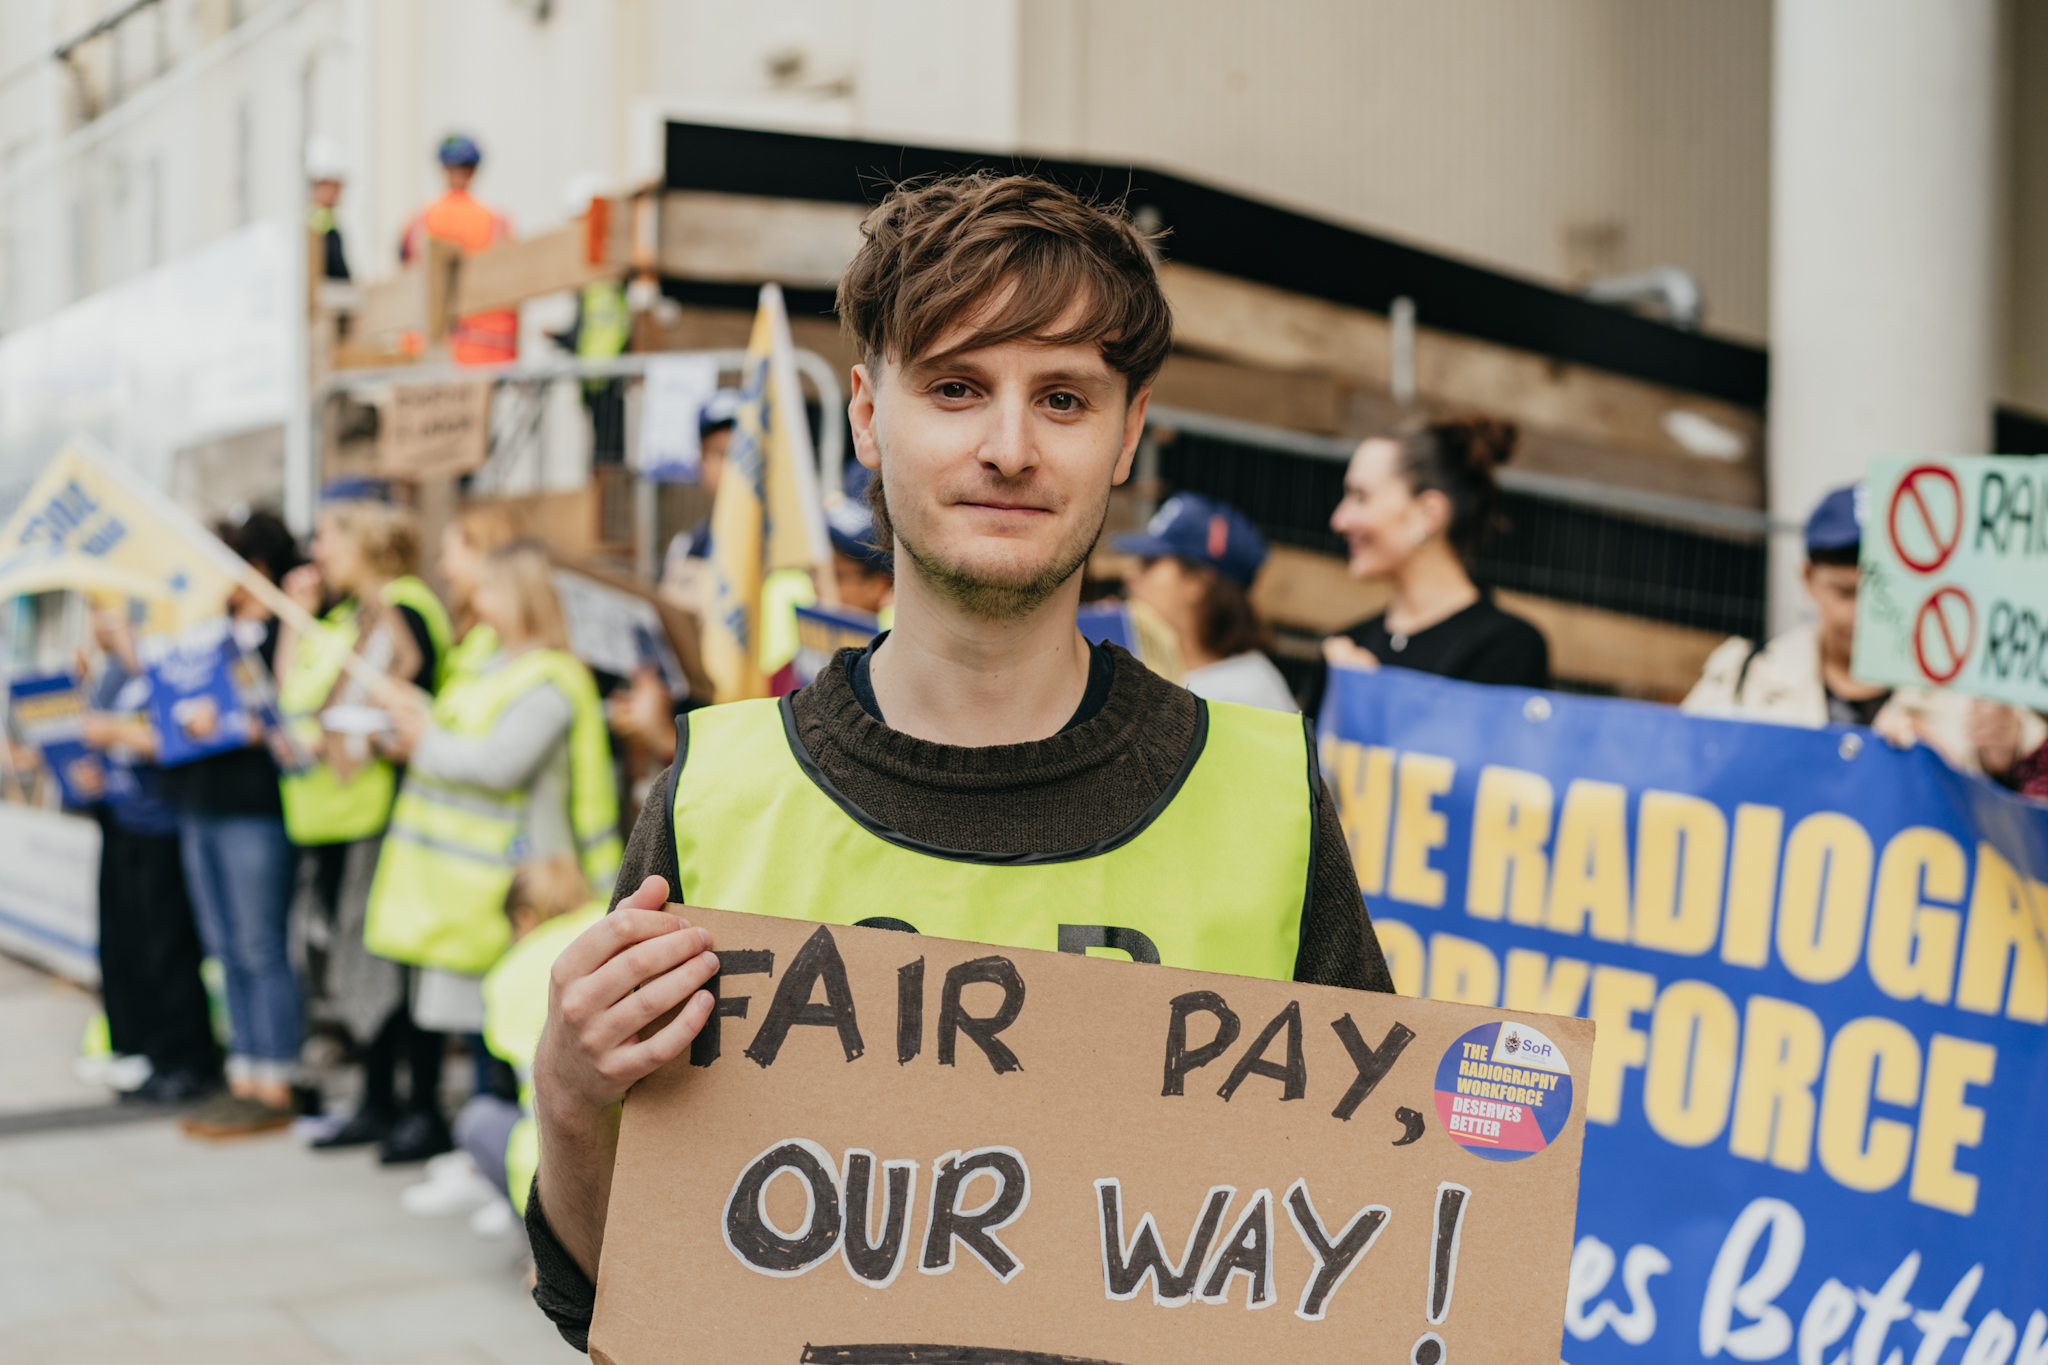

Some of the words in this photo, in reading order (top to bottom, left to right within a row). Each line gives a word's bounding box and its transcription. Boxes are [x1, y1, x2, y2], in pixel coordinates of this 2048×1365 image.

[1466, 764, 2048, 1026] RADIOGR
[690, 925, 1026, 1074] FAIR
[1161, 990, 1426, 1146] PAY,
[1522, 1039, 1552, 1057] SoR
[1463, 1042, 1489, 1061] THE
[1459, 1060, 1559, 1091] RADIOGRAPHY
[1457, 1077, 1544, 1107] WORKFORCE
[1452, 1096, 1522, 1123] DESERVES
[1449, 1114, 1501, 1137] BETTER
[721, 1138, 1032, 1289] OUR
